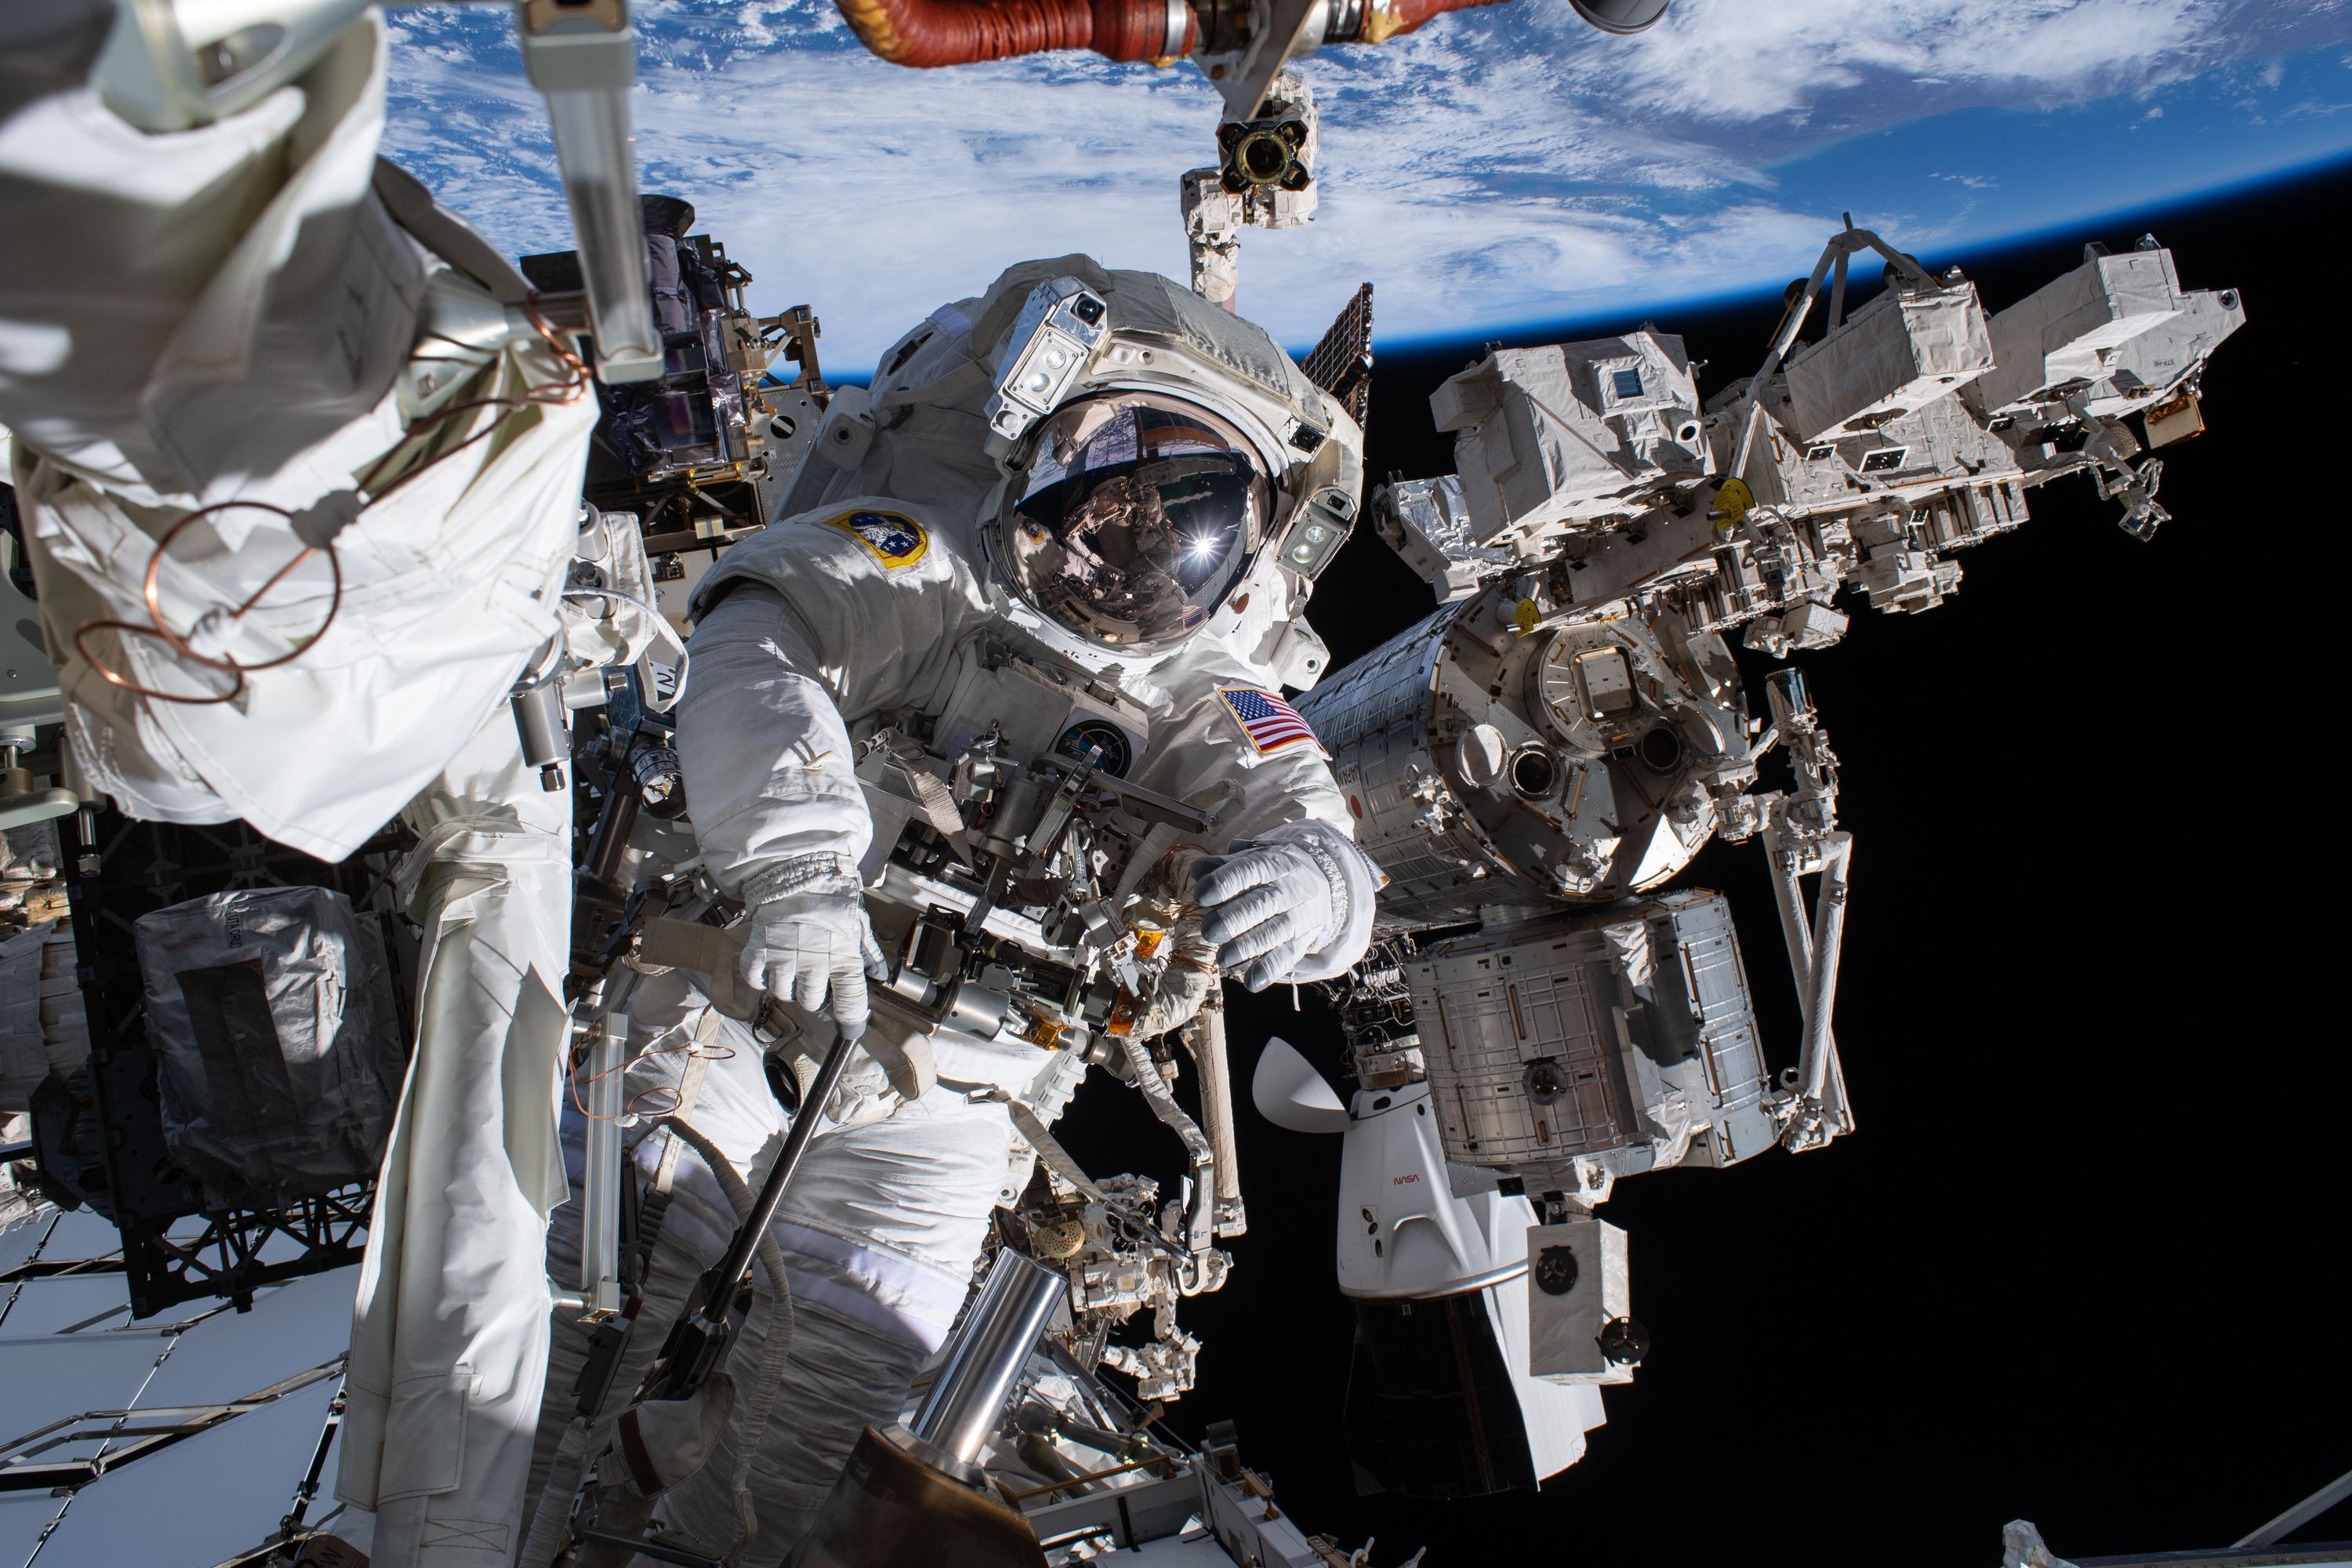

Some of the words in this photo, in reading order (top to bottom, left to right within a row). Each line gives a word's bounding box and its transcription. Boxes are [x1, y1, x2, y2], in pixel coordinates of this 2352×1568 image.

[1338, 764, 1358, 787] JAPAN
[228, 915, 241, 929] UTA
[1393, 1174, 1420, 1185] NASA
